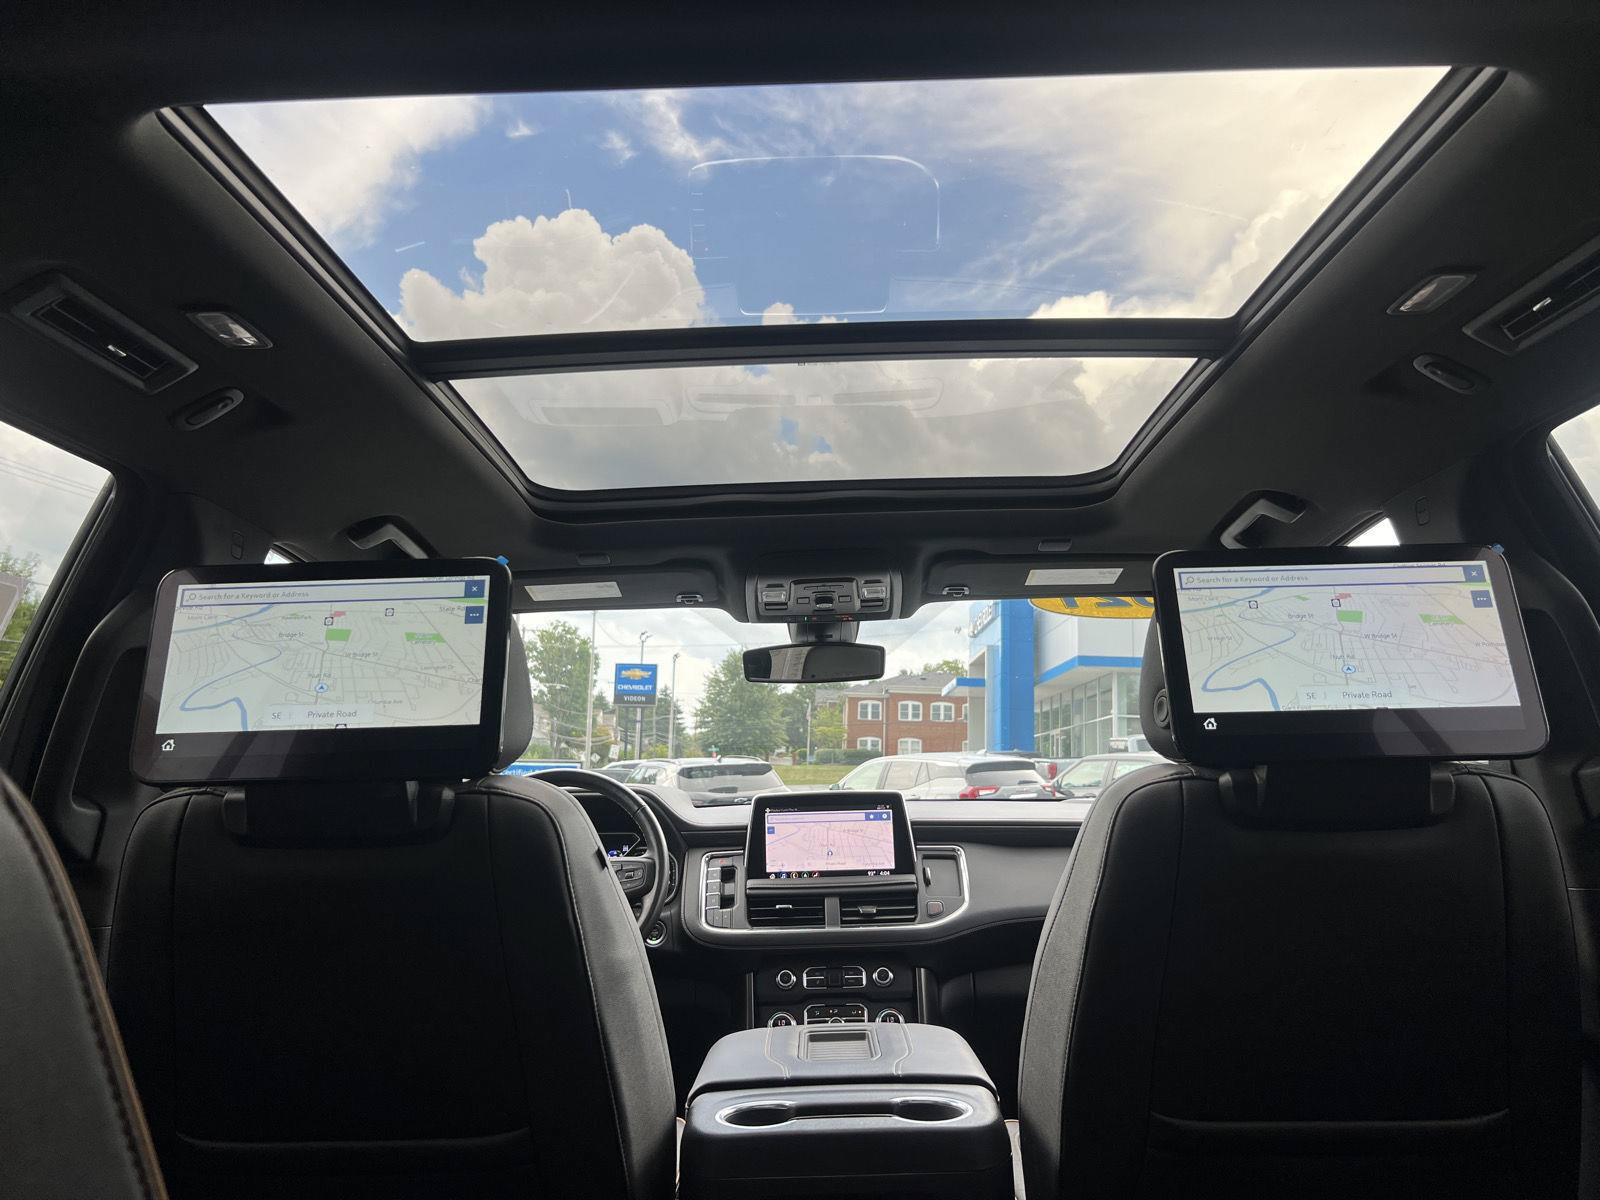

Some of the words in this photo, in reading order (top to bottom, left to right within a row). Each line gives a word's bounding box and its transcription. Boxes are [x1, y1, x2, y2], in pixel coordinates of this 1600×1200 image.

[1196, 576, 1220, 584] Search
[1240, 576, 1270, 584] Keyword
[198, 593, 223, 601] Search
[224, 592, 234, 600] for
[240, 591, 271, 600] Keyword
[281, 590, 310, 598] Address
[1306, 692, 1316, 700] SE
[1342, 691, 1370, 699] Private
[1372, 690, 1392, 698] Road
[272, 712, 282, 720] SE
[307, 710, 335, 718] Private
[336, 710, 358, 718] Road
